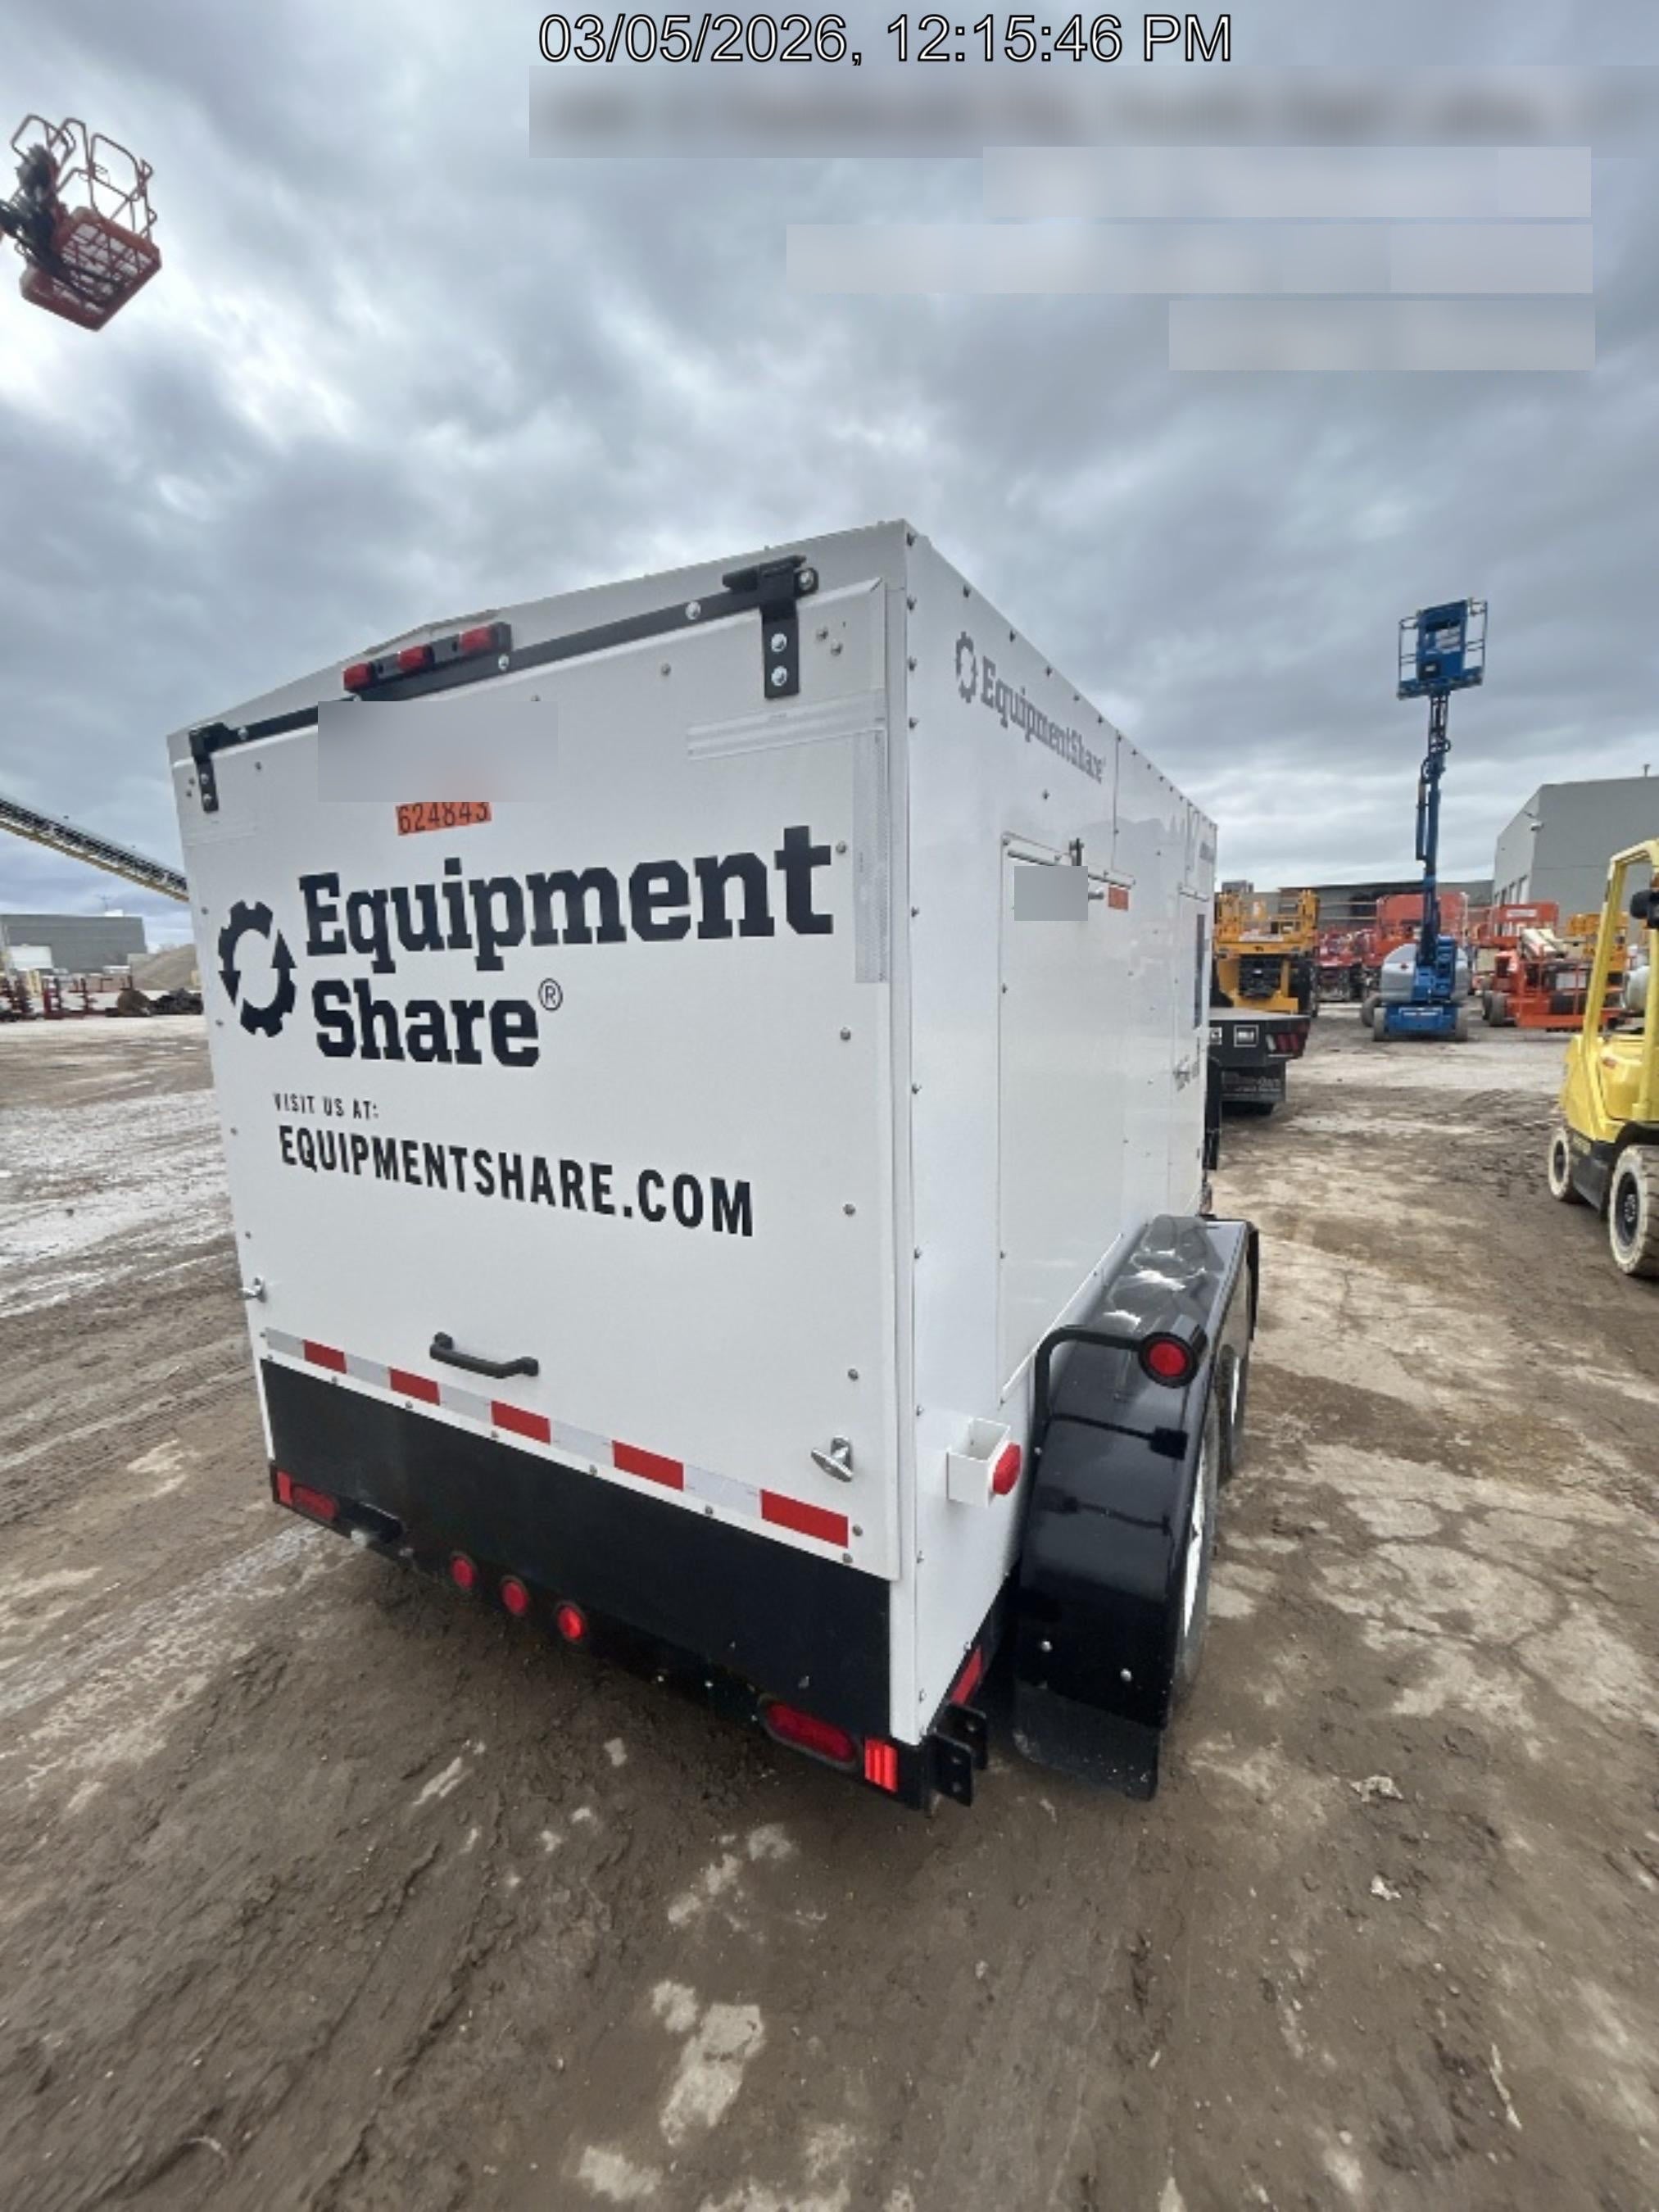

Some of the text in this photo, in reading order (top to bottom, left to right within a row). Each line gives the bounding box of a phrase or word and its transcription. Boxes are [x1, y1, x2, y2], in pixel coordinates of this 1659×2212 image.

[298, 825, 834, 973] Equipment
[274, 1093, 378, 1121] VISIT US AT:
[279, 1125, 754, 1237] EQUIPMENTSHARE.COM
